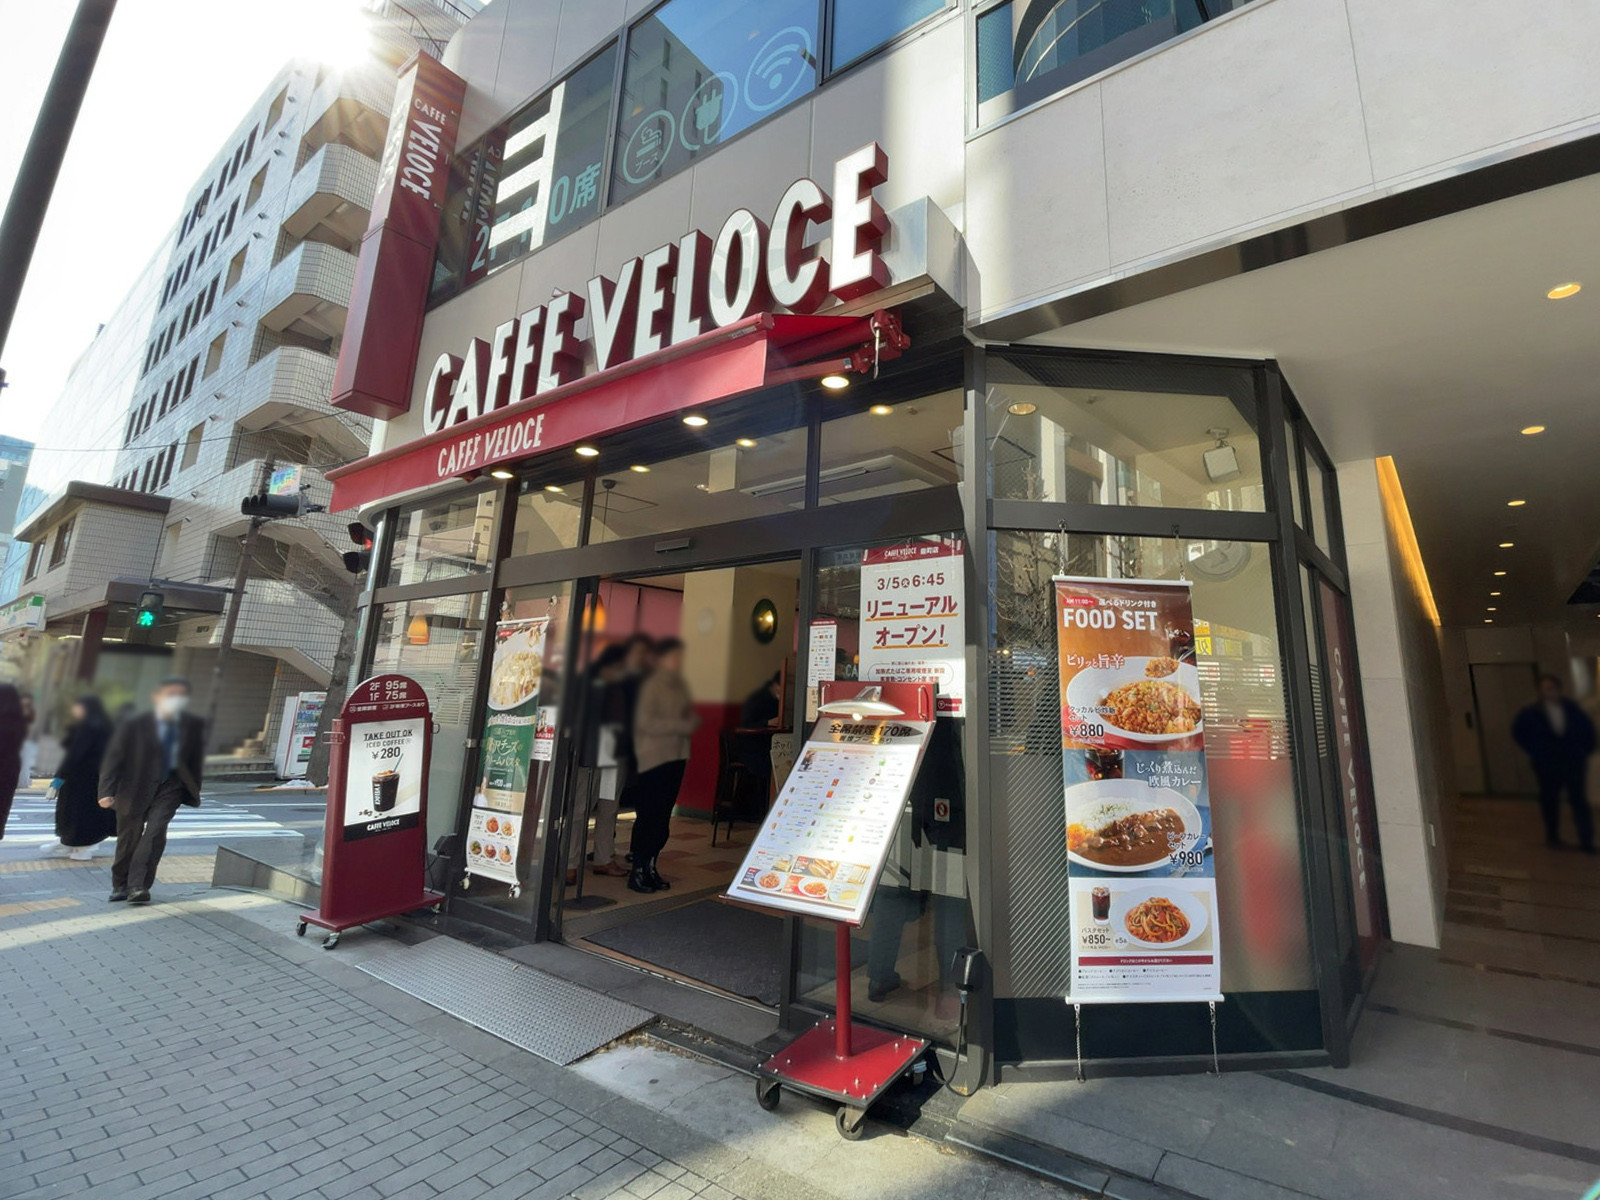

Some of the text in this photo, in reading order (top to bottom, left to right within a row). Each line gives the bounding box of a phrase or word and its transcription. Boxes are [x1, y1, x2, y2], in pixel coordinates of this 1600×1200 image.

[400, 118, 442, 200] VELOCE
[587, 141, 885, 371] VELOCE
[482, 413, 546, 463] VELOCE
[867, 595, 958, 619] リニューアル
[1063, 608, 1158, 631] FOOD SET
[369, 682, 381, 691] 2F
[369, 692, 380, 701] 1F
[364, 729, 413, 741] TAKE OUT OK
[1070, 723, 1104, 737] ¥880
[372, 746, 401, 760] ¥280
[1136, 760, 1197, 775] じっくり煮込んだ
[1148, 775, 1201, 787] 欧風カレー
[1346, 756, 1367, 890] VELOCE
[1168, 842, 1186, 850] セット
[1169, 850, 1203, 866] ¥980
